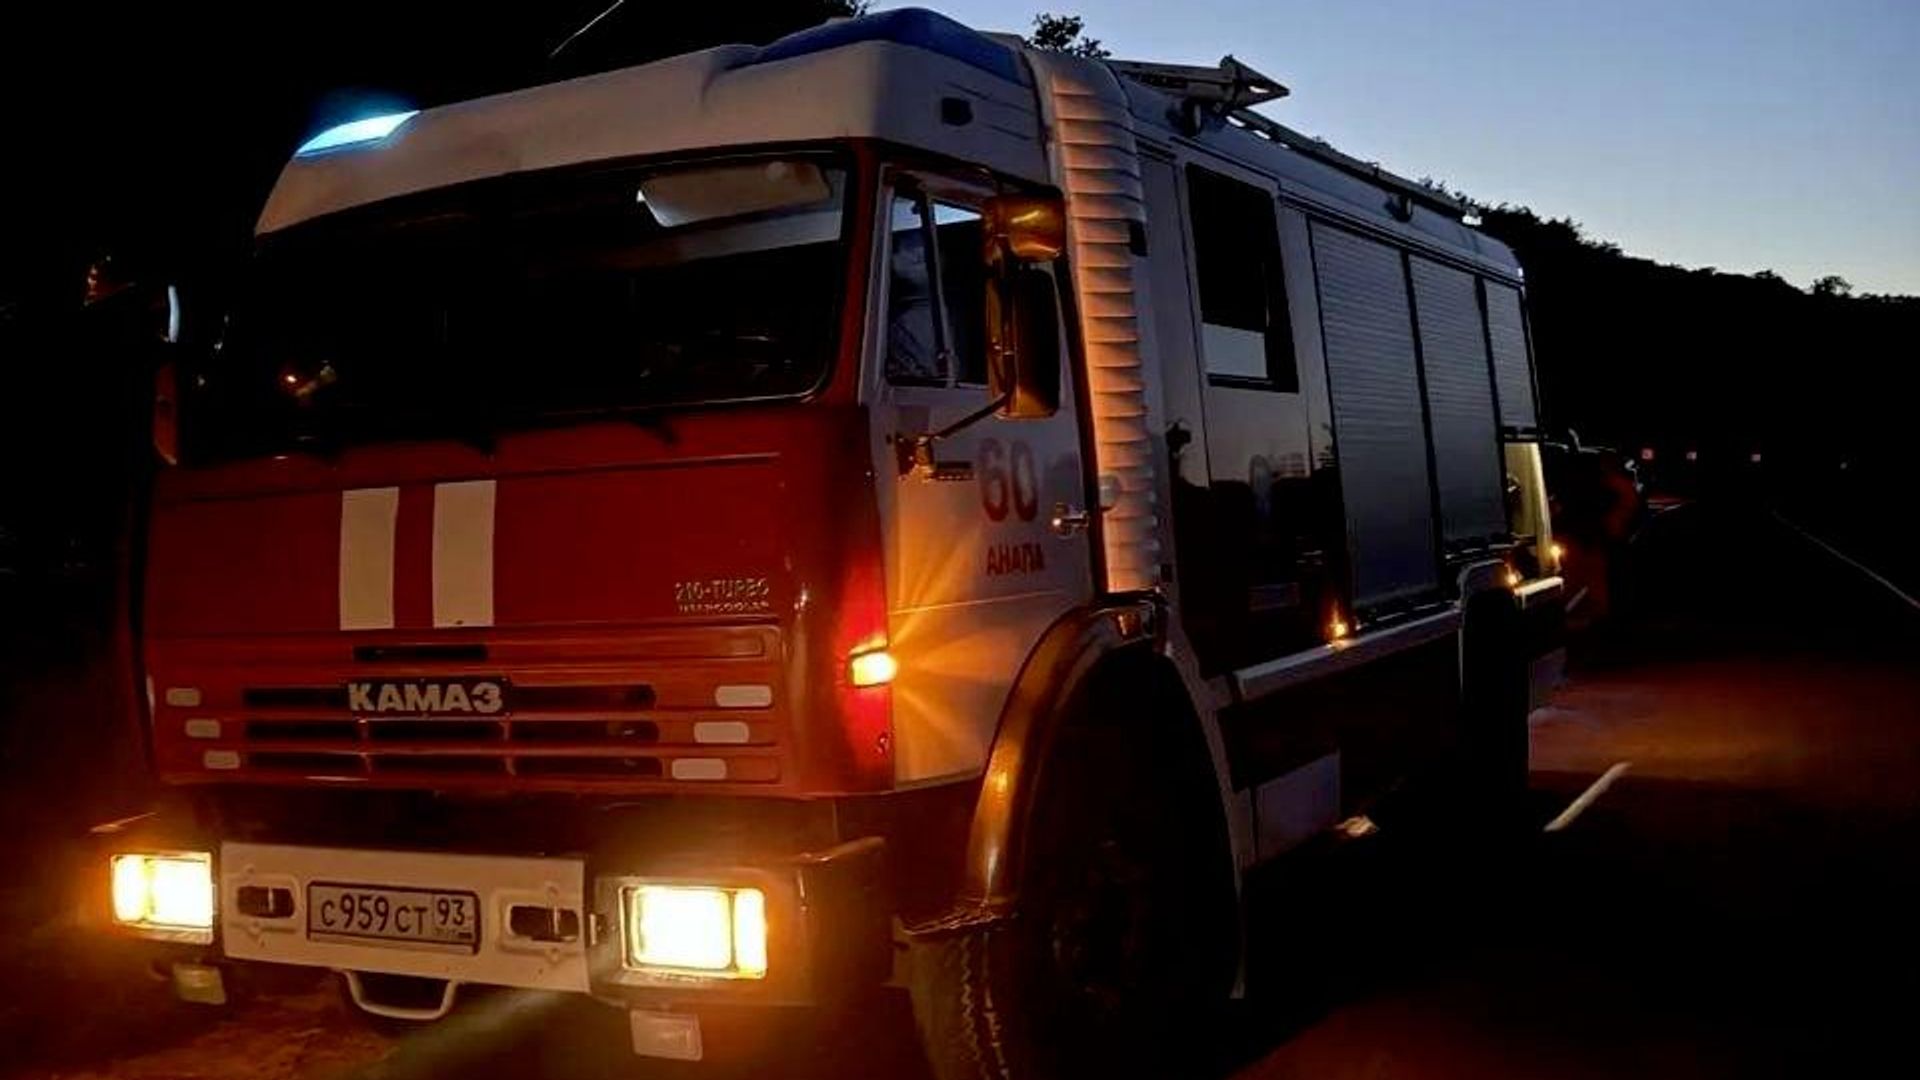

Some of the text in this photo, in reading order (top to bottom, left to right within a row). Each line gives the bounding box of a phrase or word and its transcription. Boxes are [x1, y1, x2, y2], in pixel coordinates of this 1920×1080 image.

[978, 438, 1038, 522] 60
[987, 543, 1044, 575] АНАПА
[349, 682, 502, 713] КАМАЗ
[438, 898, 465, 926] 93
